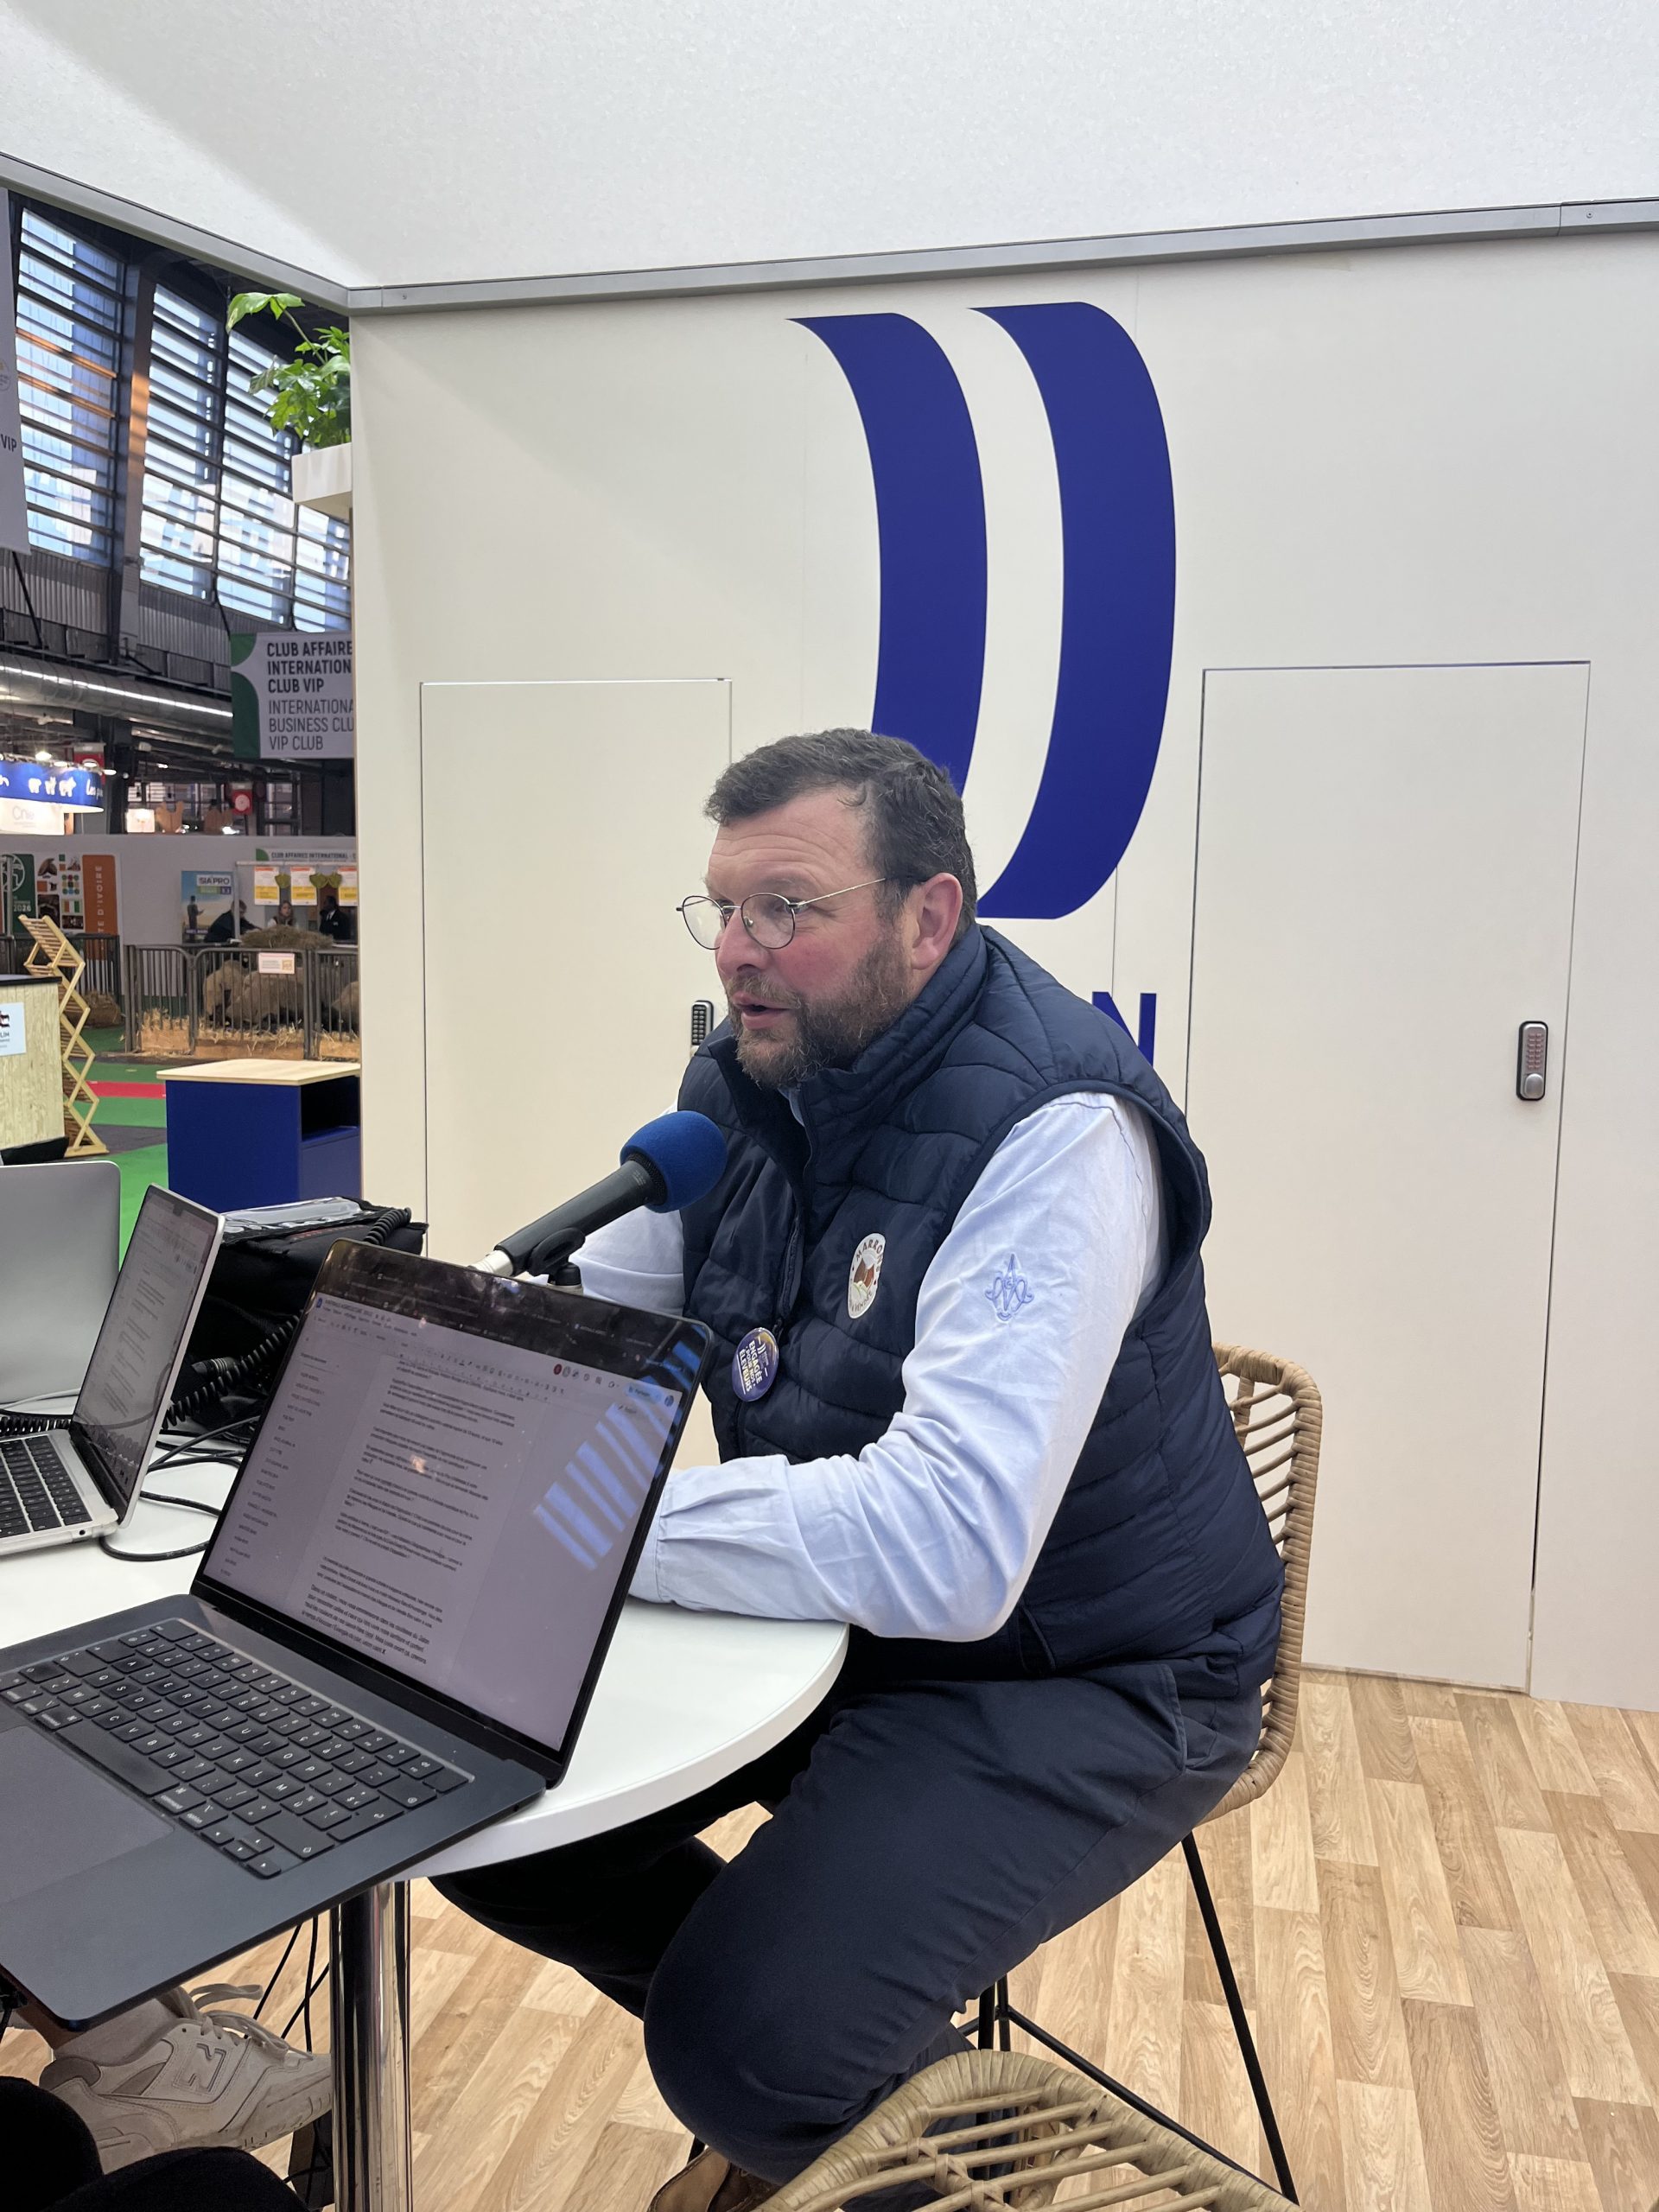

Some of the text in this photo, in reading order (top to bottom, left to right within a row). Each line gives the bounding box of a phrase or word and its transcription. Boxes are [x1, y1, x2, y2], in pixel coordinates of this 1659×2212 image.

[267, 642, 299, 657] CLUB
[268, 678, 324, 693] CLUB VIP
[269, 718, 328, 733] BUSINESS
[270, 735, 323, 750] VIP CLUB
[748, 1339, 763, 1384] ENGAGÉE
[739, 1348, 753, 1392] ÉLEVEURS
